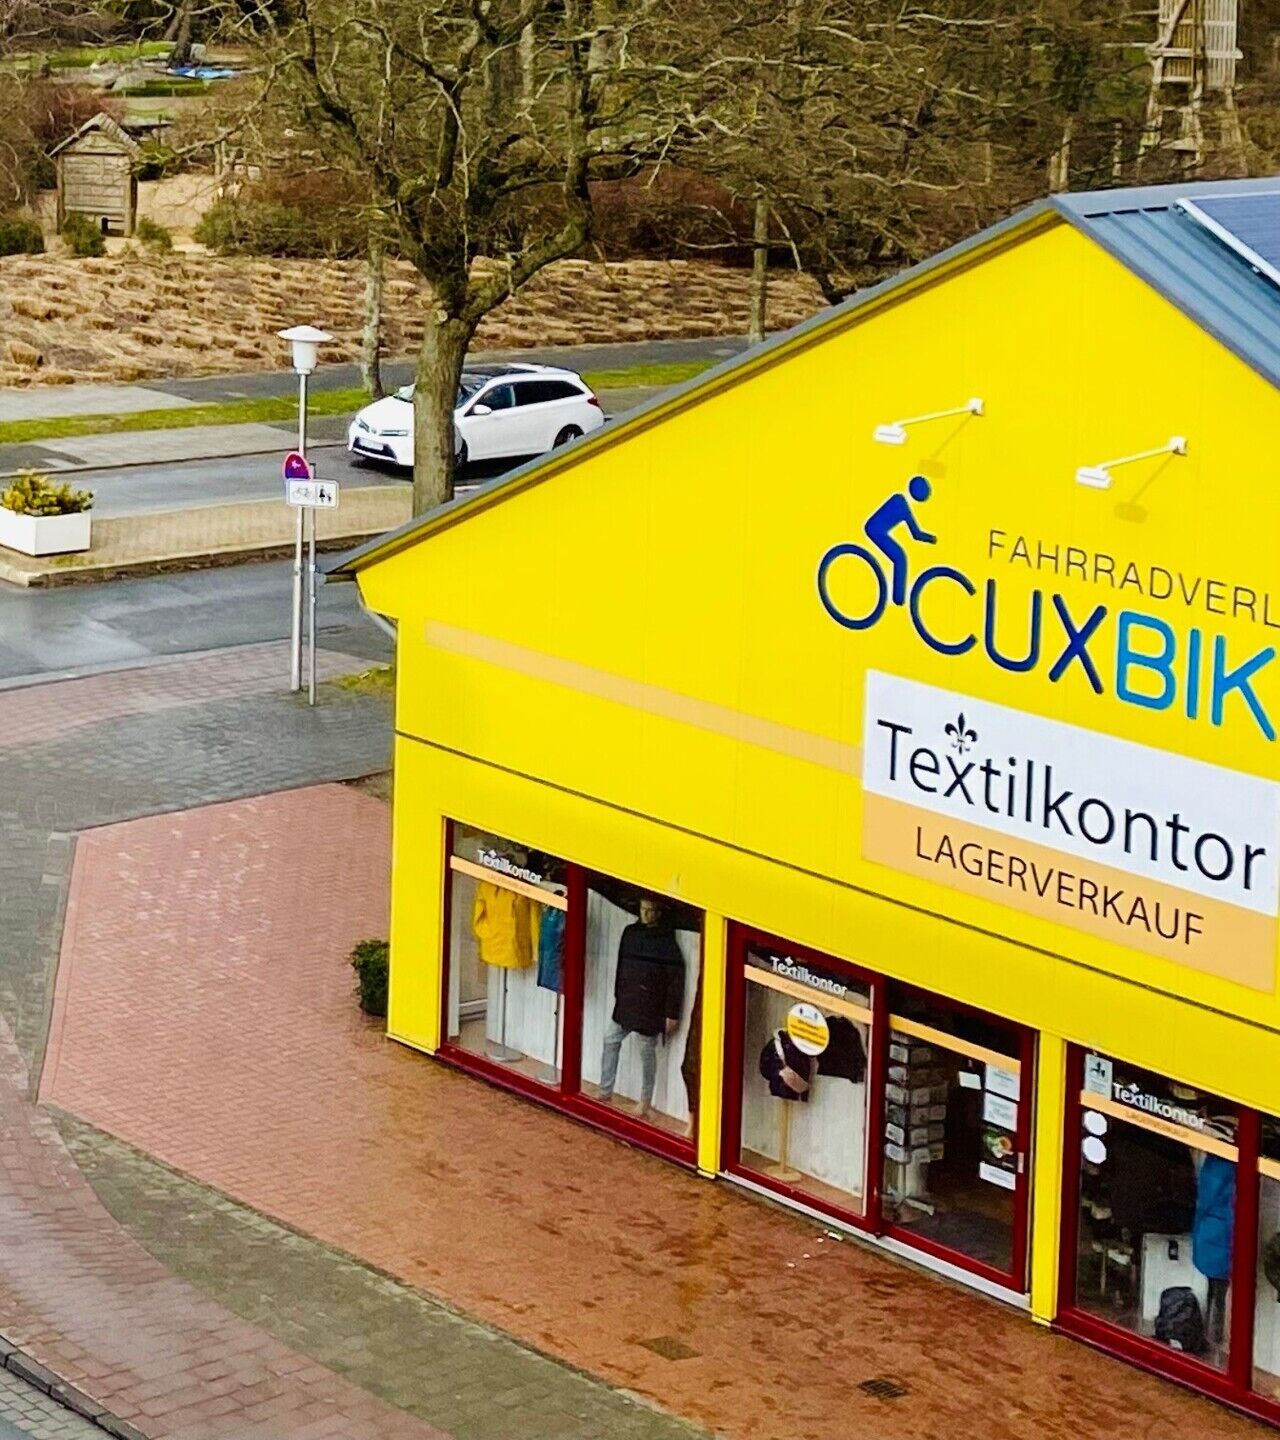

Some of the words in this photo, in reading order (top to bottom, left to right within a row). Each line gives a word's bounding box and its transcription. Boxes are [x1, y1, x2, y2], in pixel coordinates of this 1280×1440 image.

[988, 529, 1280, 629] FAHRRADVERL
[876, 718, 1267, 890] Textilkontor
[915, 825, 1205, 946] LAGERVERKAUF
[770, 956, 848, 997] Textilkontor
[1112, 1082, 1207, 1131] Textilkontor
